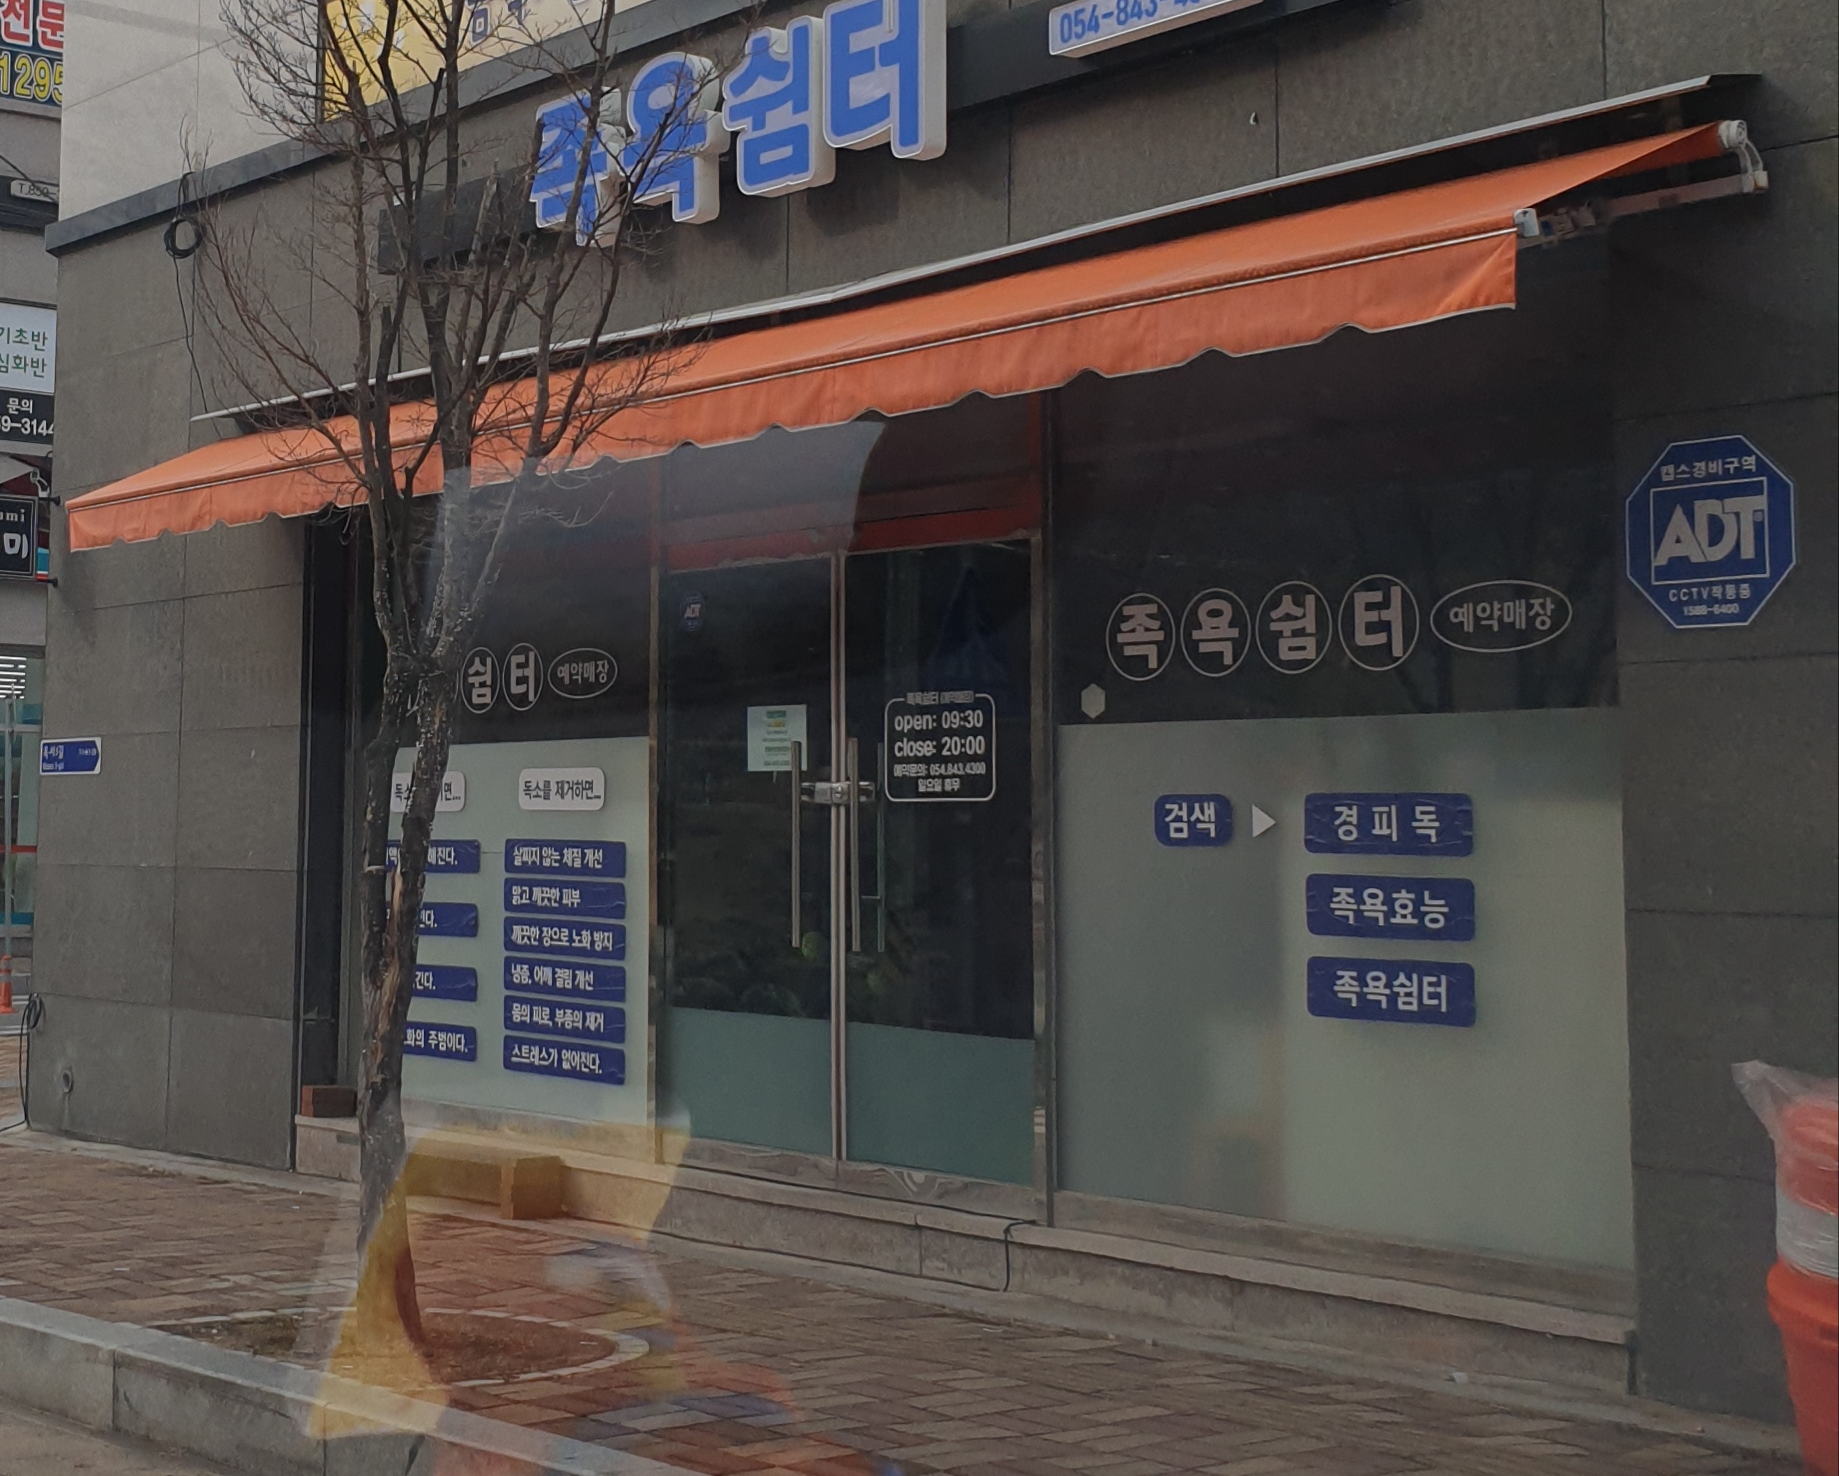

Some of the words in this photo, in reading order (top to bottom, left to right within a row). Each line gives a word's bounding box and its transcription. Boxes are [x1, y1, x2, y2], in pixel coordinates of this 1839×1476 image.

[0, 327, 48, 352] 기초반
[7, 397, 33, 415] 문의
[0, 415, 54, 437] 9-3144
[1660, 455, 1756, 482] 캡스경비구역
[1653, 494, 1766, 566] ADT
[1449, 596, 1555, 633] 예약매장
[557, 660, 610, 685] 예약매장
[894, 714, 937, 733] open:
[941, 709, 984, 728] 09:30
[894, 737, 937, 757] close:
[941, 735, 985, 756] 20:00
[523, 780, 552, 801] 독소를
[1164, 802, 1217, 838] 검색
[542, 847, 560, 867] 않는
[563, 847, 582, 868] 체질
[584, 848, 603, 869] 개선
[512, 886, 530, 905] 맑고
[532, 887, 560, 907] 깨끗한
[562, 889, 581, 908] 피부
[1329, 887, 1450, 929] 족욕효능
[511, 925, 540, 945] 깨끗한
[542, 927, 570, 947] 장으로
[572, 929, 591, 950] 노화
[594, 931, 613, 952] 방지
[534, 966, 553, 986] 어깨
[575, 970, 594, 991] 개선
[1333, 970, 1447, 1012] 족욕쉼터
[512, 1003, 530, 1024] 몸의
[585, 1012, 604, 1033] 제거
[404, 1027, 424, 1048] 화의
[428, 1031, 468, 1053] 주범이다.
[511, 1044, 558, 1068] 스트레스가
[561, 1049, 602, 1074] 없어진다.
